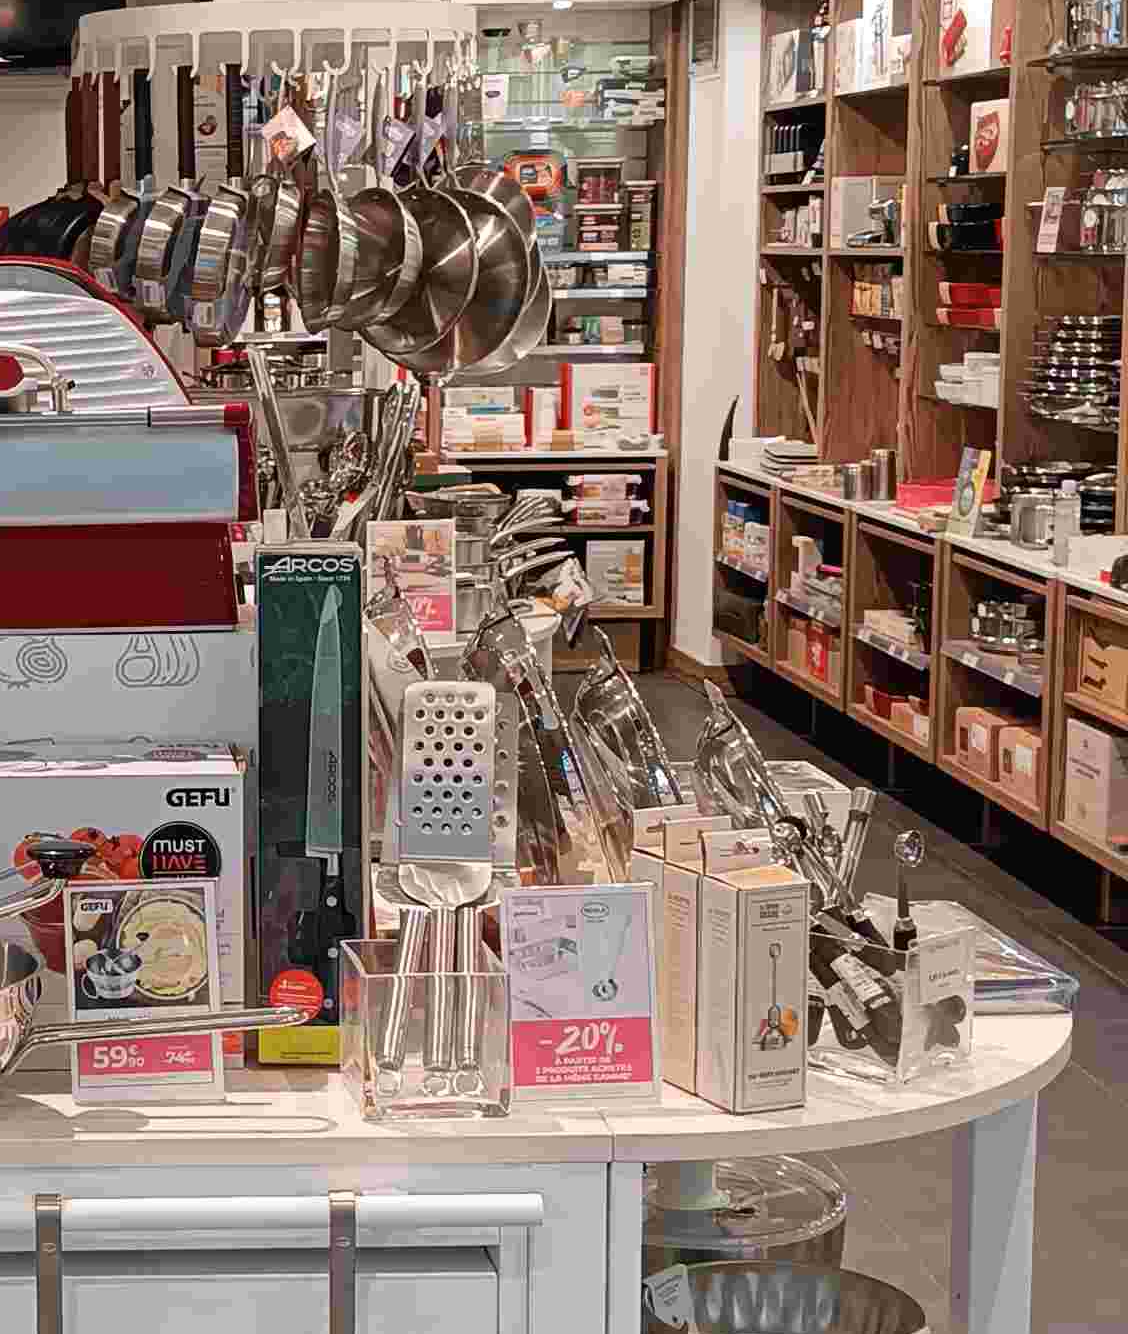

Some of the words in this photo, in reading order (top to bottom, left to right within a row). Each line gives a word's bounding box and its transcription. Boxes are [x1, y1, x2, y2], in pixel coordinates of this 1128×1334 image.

[262, 555, 358, 578] ARCOS
[165, 787, 230, 807] GEFU
[152, 854, 208, 870] HAVE
[538, 1020, 624, 1056] -20%
